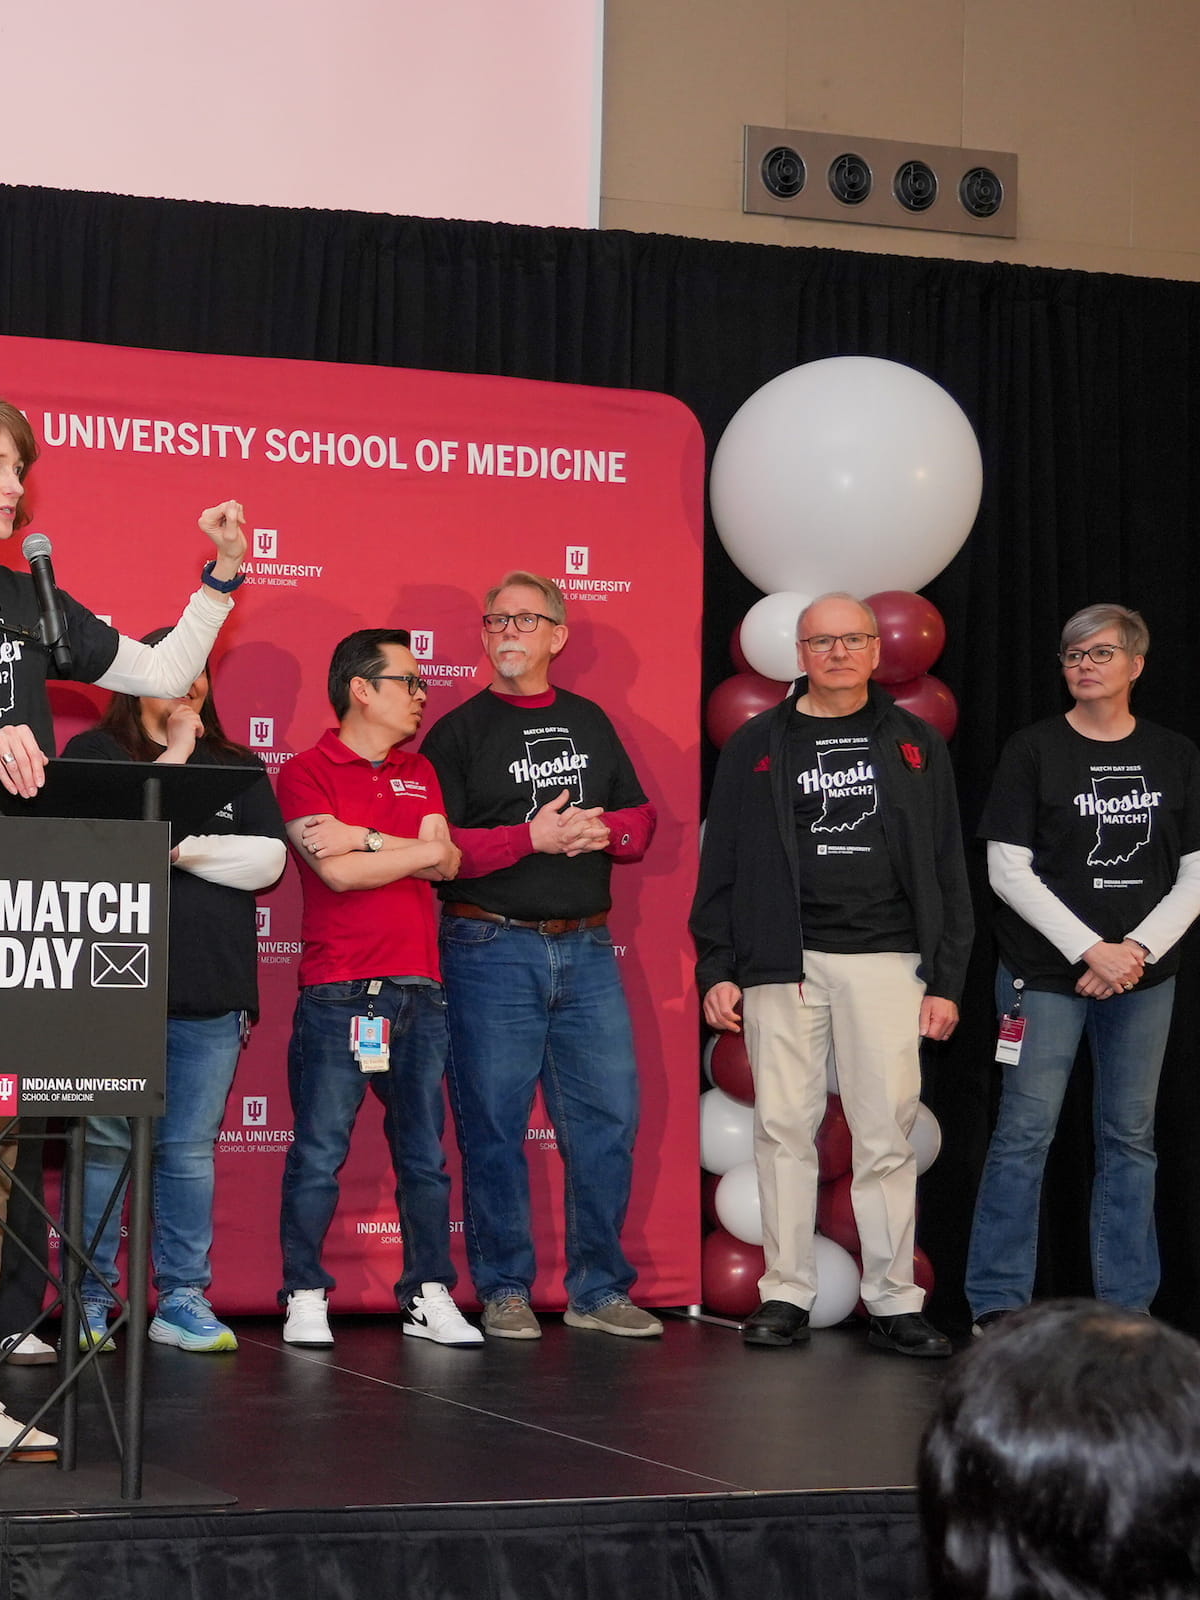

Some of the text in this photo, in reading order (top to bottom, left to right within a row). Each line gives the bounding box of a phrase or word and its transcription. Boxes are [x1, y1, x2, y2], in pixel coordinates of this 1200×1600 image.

[43, 412, 626, 484] UNIVERSITY SCHOOL OF MEDICINE
[256, 563, 323, 577] UNIVERSITY
[258, 577, 266, 585] OF
[267, 578, 298, 587] MEDICINE
[568, 579, 632, 592] UNIVERSITY
[508, 750, 589, 783] Hoosier
[536, 774, 578, 788] MATCH?
[828, 785, 873, 798] MATCH?
[1073, 789, 1162, 817] Hoosier
[1102, 813, 1148, 824] MATCH?
[257, 942, 302, 953] NIVERSI
[261, 956, 292, 964] MEDICINE
[22, 1078, 147, 1091] INDIANA UNIVERSITY
[22, 1093, 94, 1102] SCHOOL OF MEDICINE
[246, 1130, 295, 1142] UNIVERS
